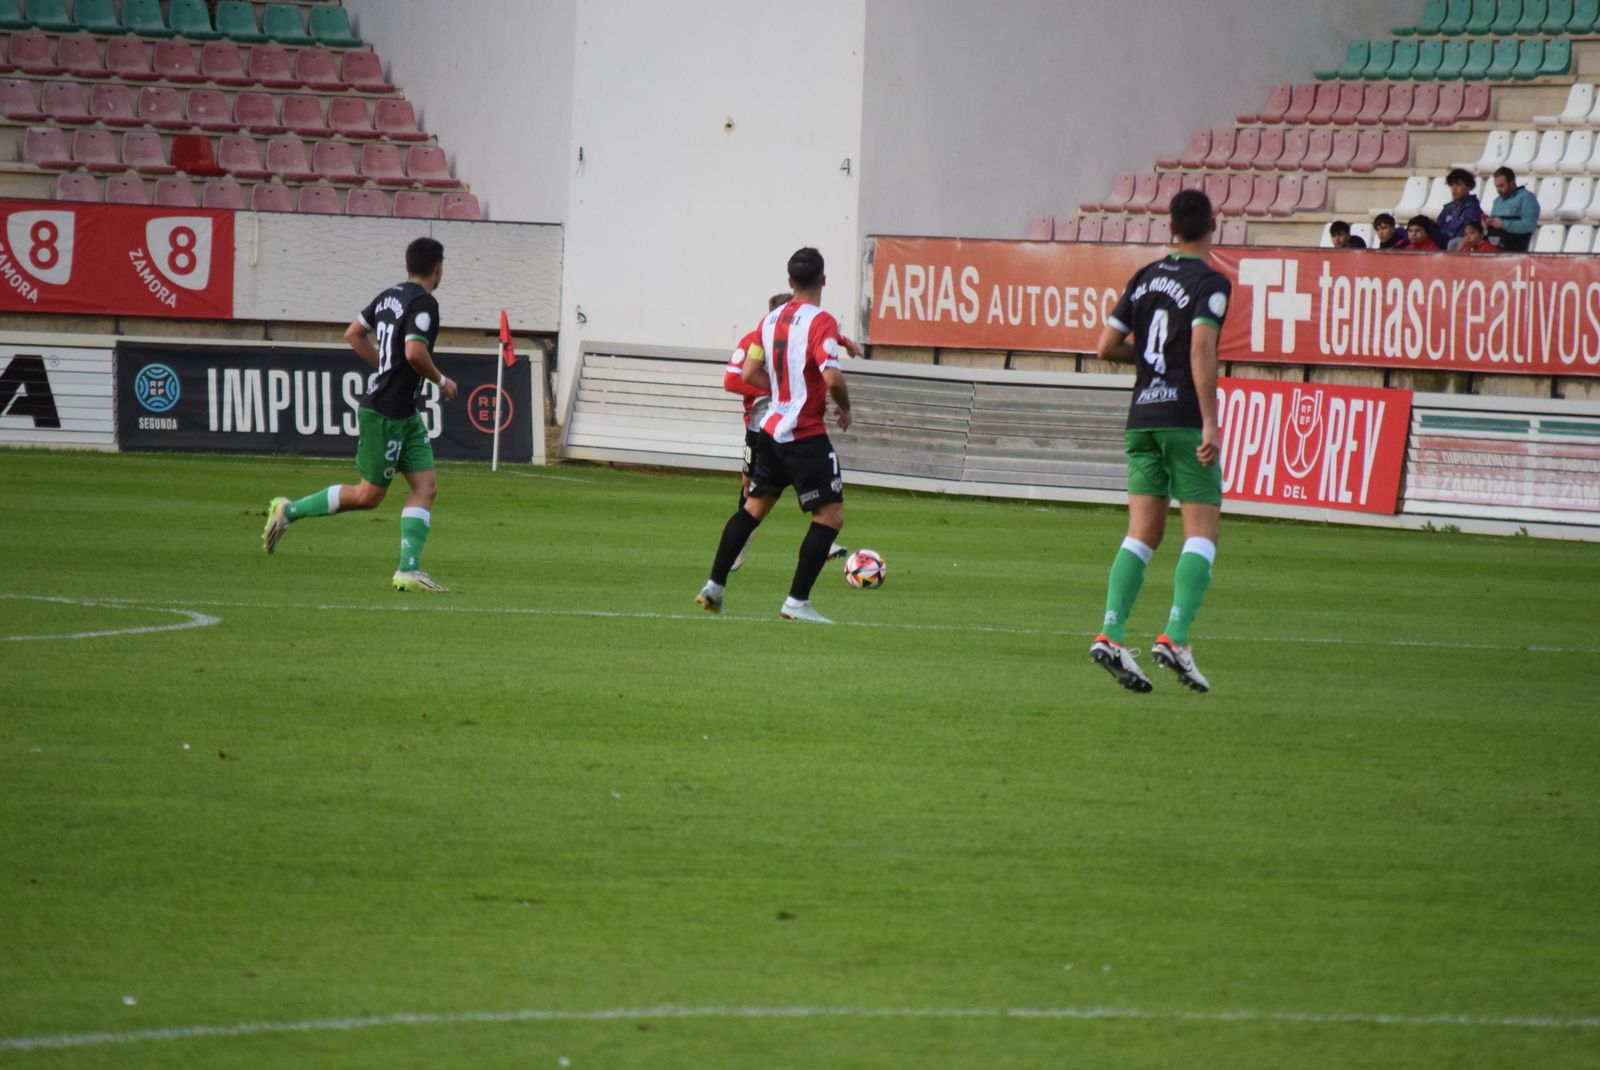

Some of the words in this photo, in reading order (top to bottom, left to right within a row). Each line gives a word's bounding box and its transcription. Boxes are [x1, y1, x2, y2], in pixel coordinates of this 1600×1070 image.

[29, 220, 59, 270] 8
[167, 226, 197, 275] 8
[128, 248, 177, 309] ZAMORA
[879, 263, 980, 324] ARIAS
[987, 284, 1125, 329] AUTOESC
[1149, 276, 1190, 309] MORENO
[376, 321, 395, 375] 21
[1144, 308, 1169, 374] 4
[139, 417, 178, 430] SEGUNDA
[385, 440, 402, 461] 21
[1318, 396, 1386, 505] REY
[1283, 484, 1307, 500] DEL
[1438, 471, 1518, 500] ZAMORA
